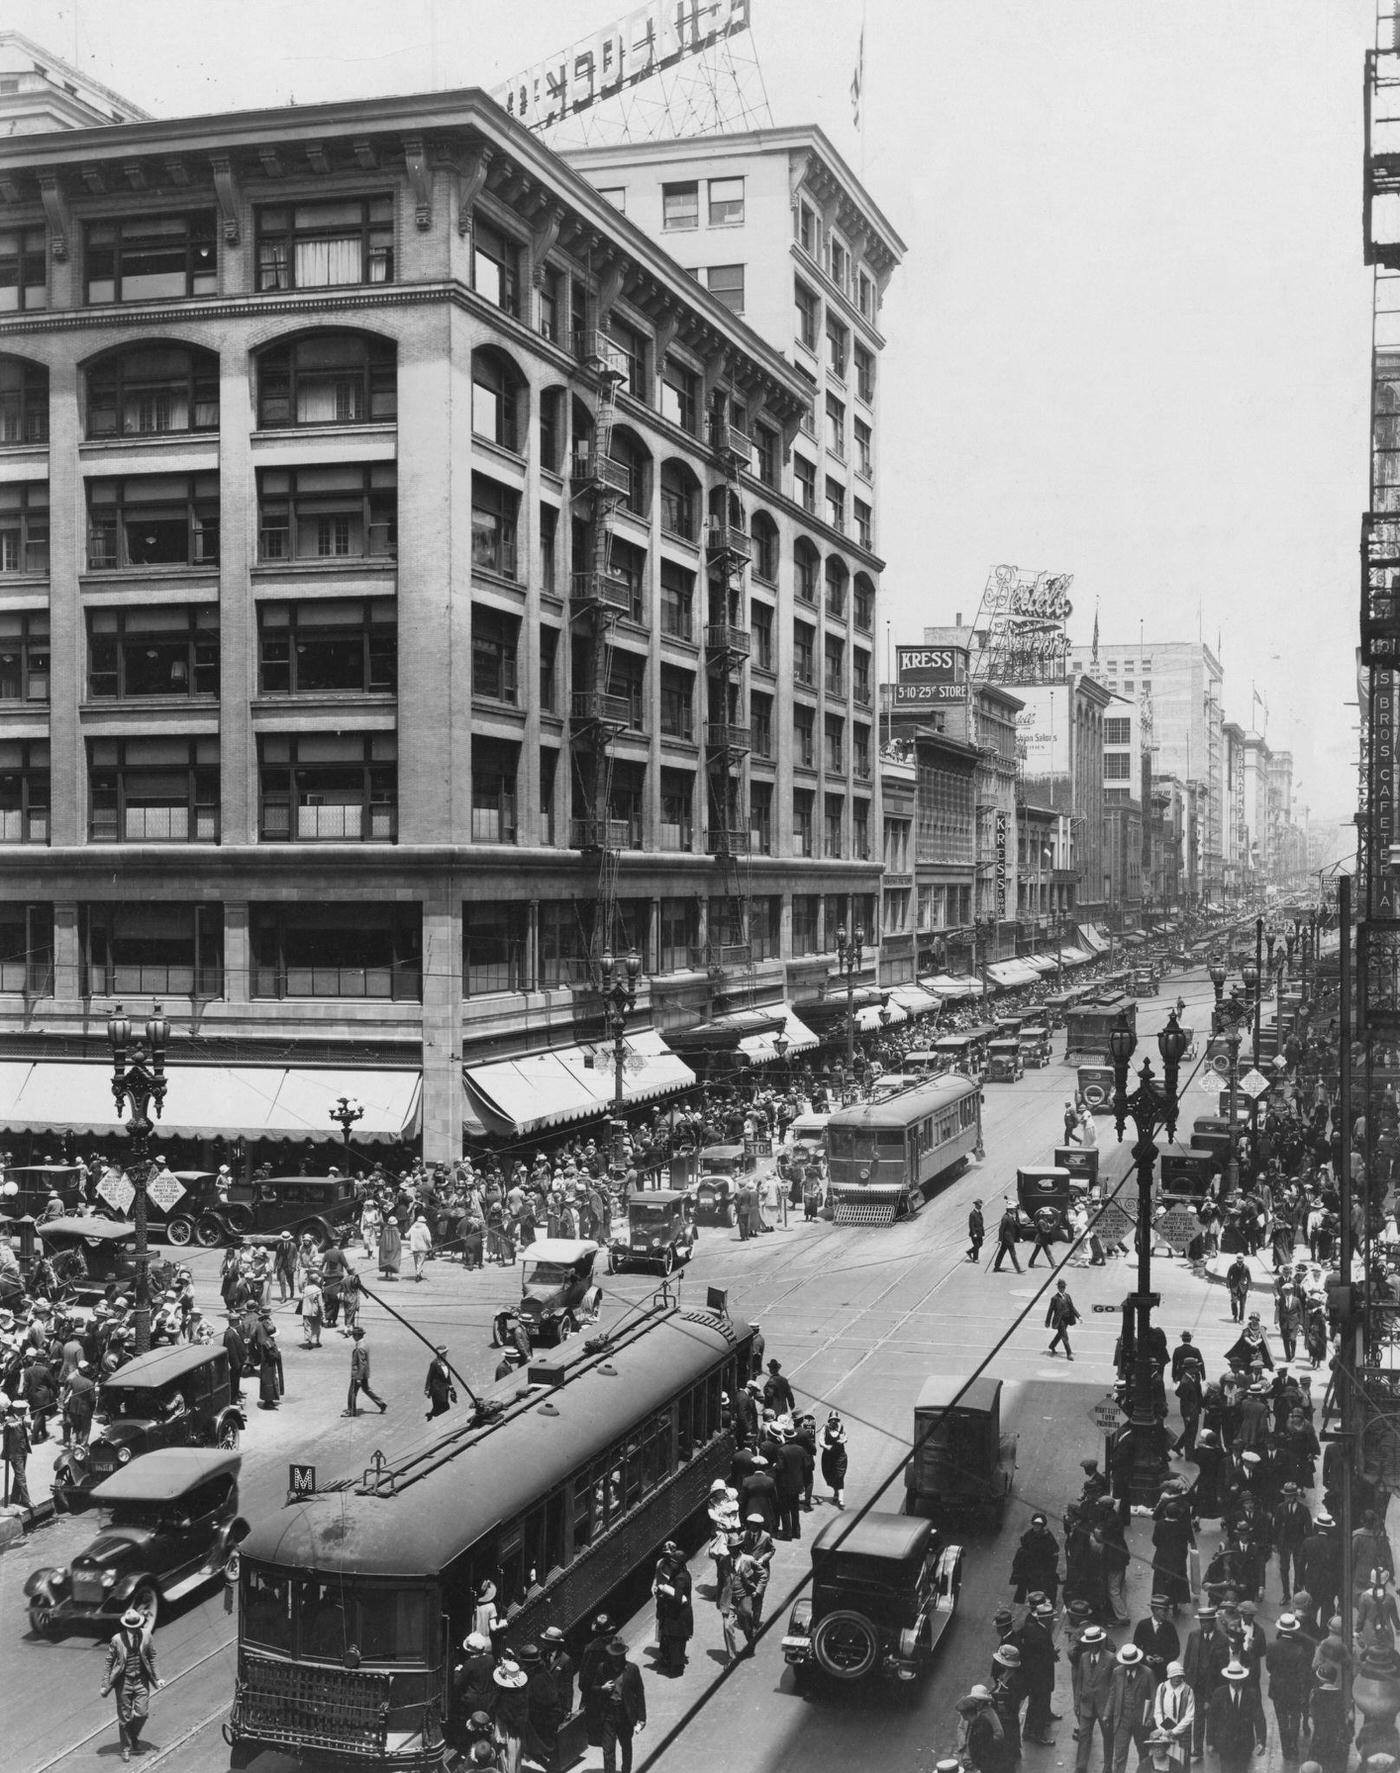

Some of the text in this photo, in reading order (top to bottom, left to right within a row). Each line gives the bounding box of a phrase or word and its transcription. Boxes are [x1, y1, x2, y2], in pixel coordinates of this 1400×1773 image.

[901, 651, 953, 671] KRESS
[938, 685, 967, 698] STORE
[997, 817, 1006, 890] KRESS
[745, 1144, 771, 1155] STOP
[1093, 1305, 1115, 1313] GO
[294, 1467, 312, 1490] M
